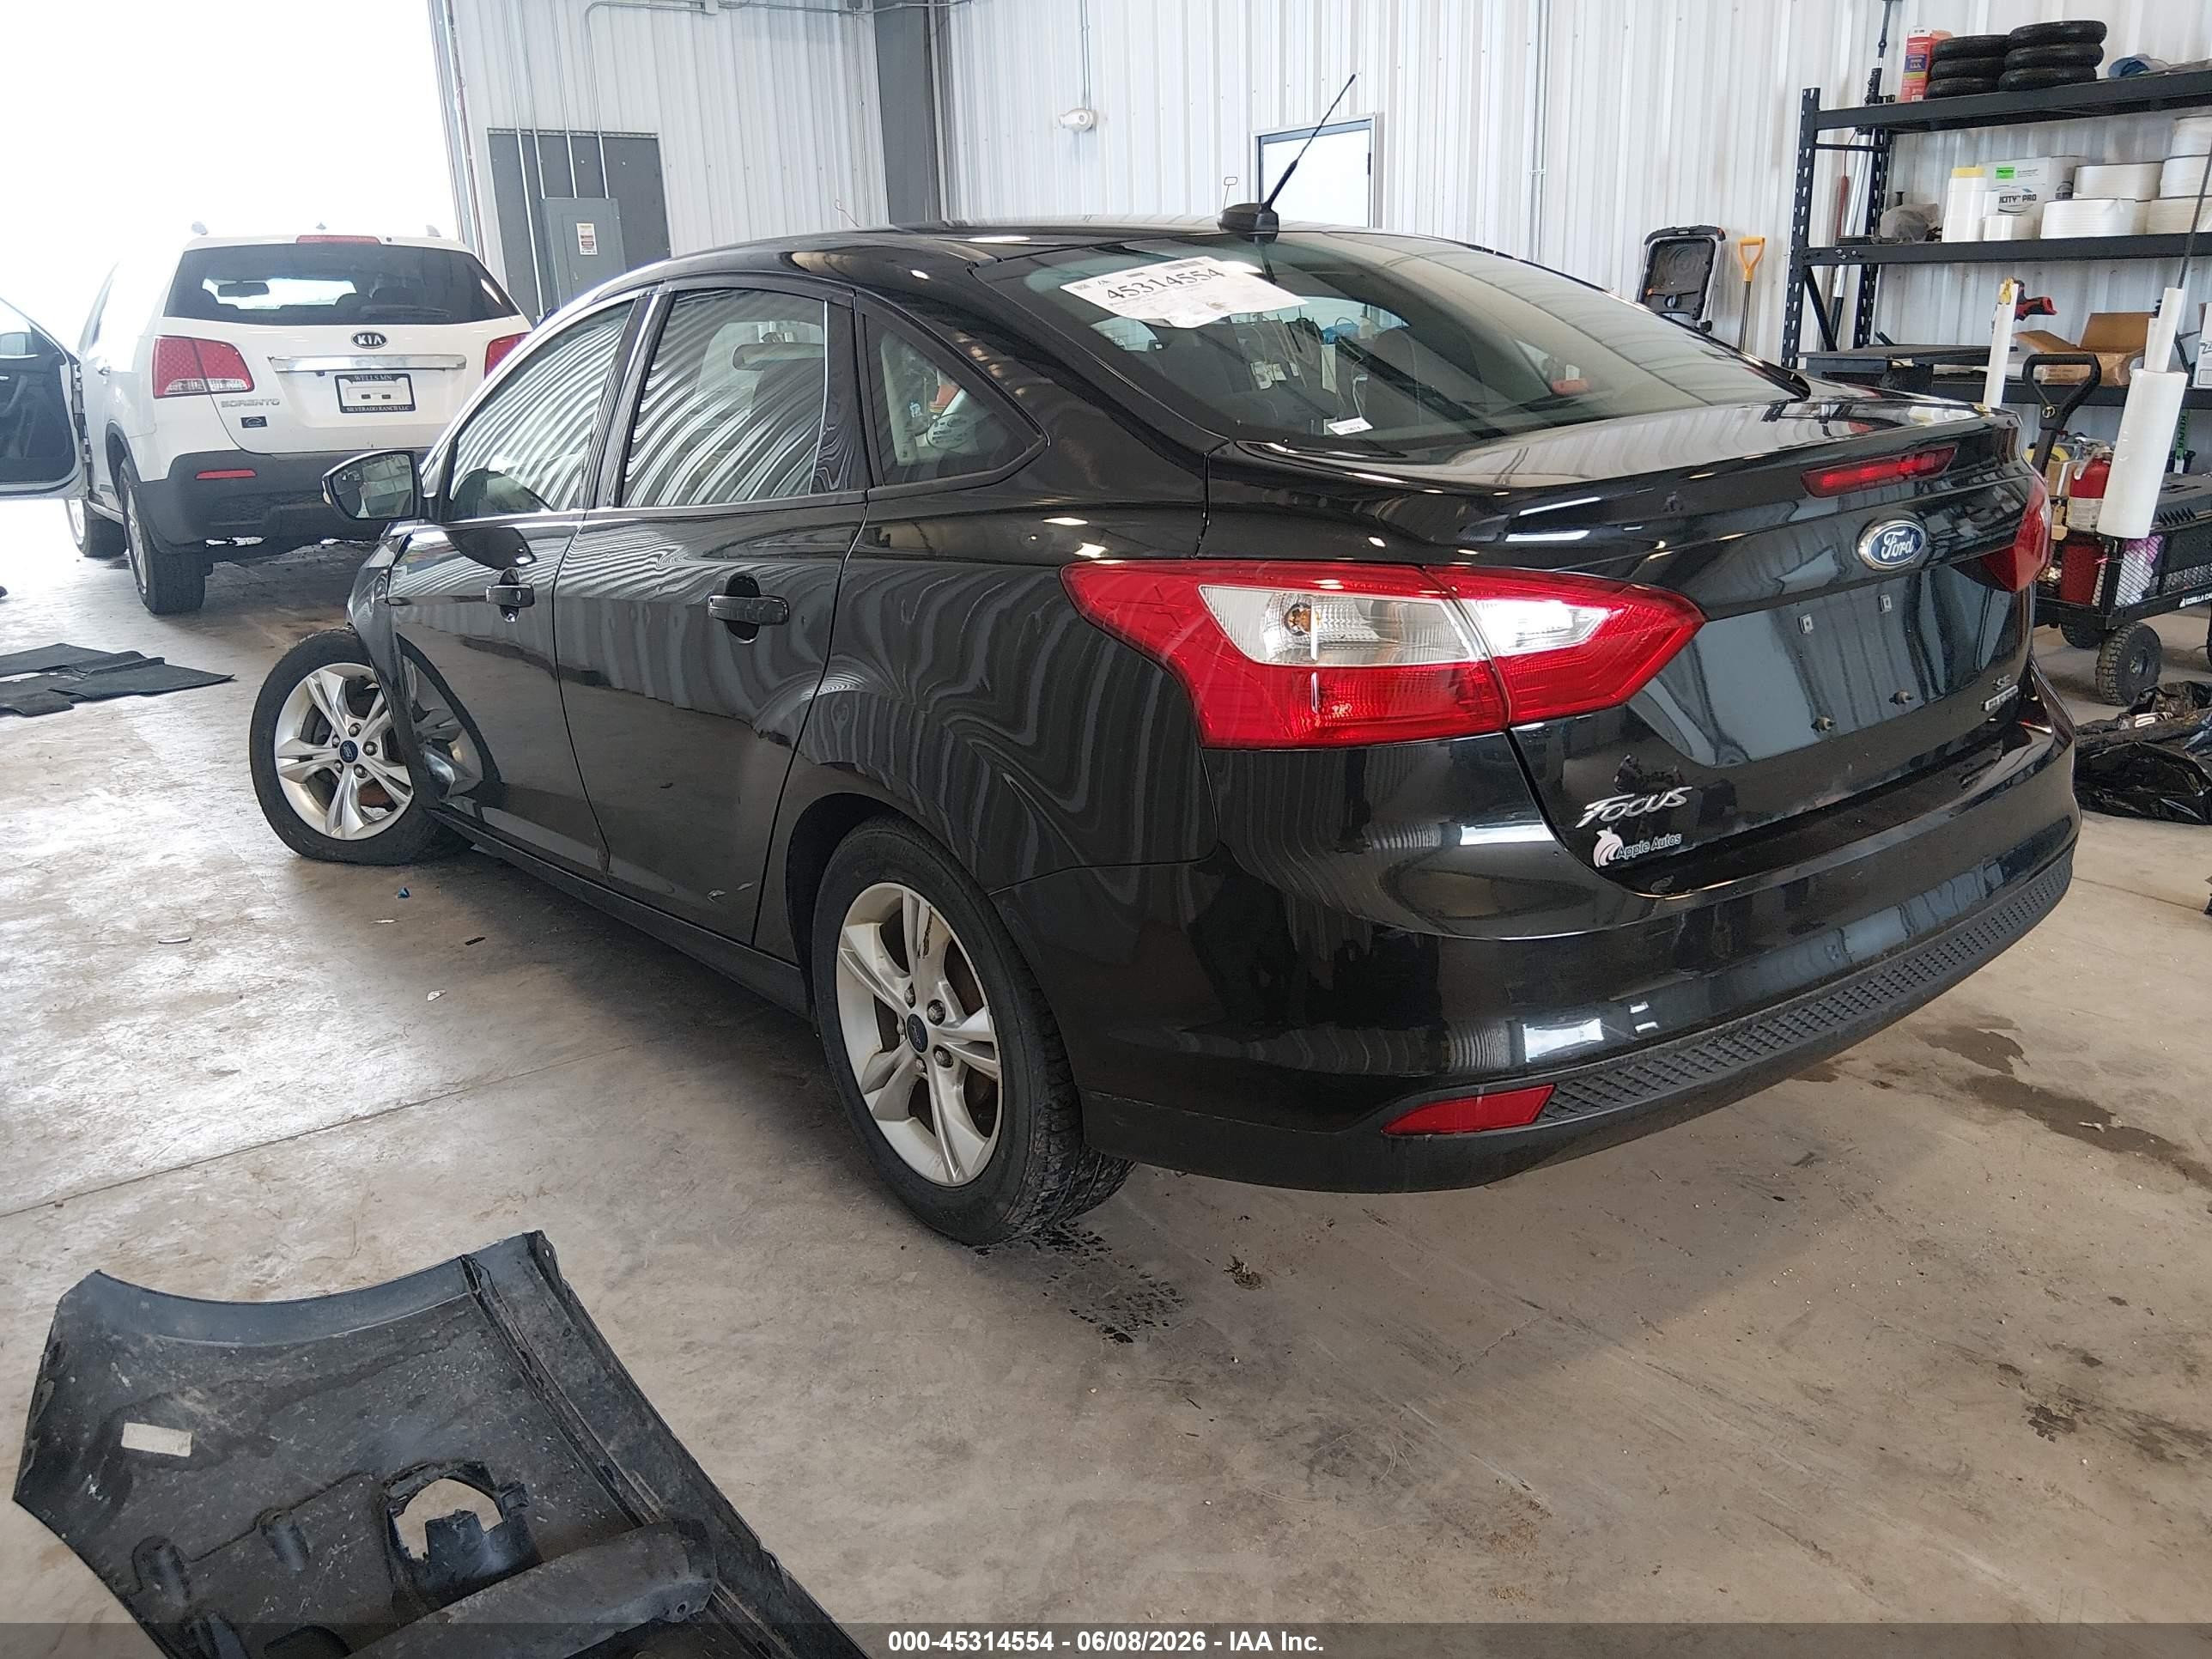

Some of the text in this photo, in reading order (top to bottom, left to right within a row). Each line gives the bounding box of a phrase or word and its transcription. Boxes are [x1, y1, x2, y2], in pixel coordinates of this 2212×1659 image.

[2021, 194, 2037, 203] PRO
[1107, 268, 1225, 300] 45314554
[356, 334, 384, 345] KIA
[1881, 530, 1915, 560] Ford
[1615, 833, 1682, 860] Apple Autos
